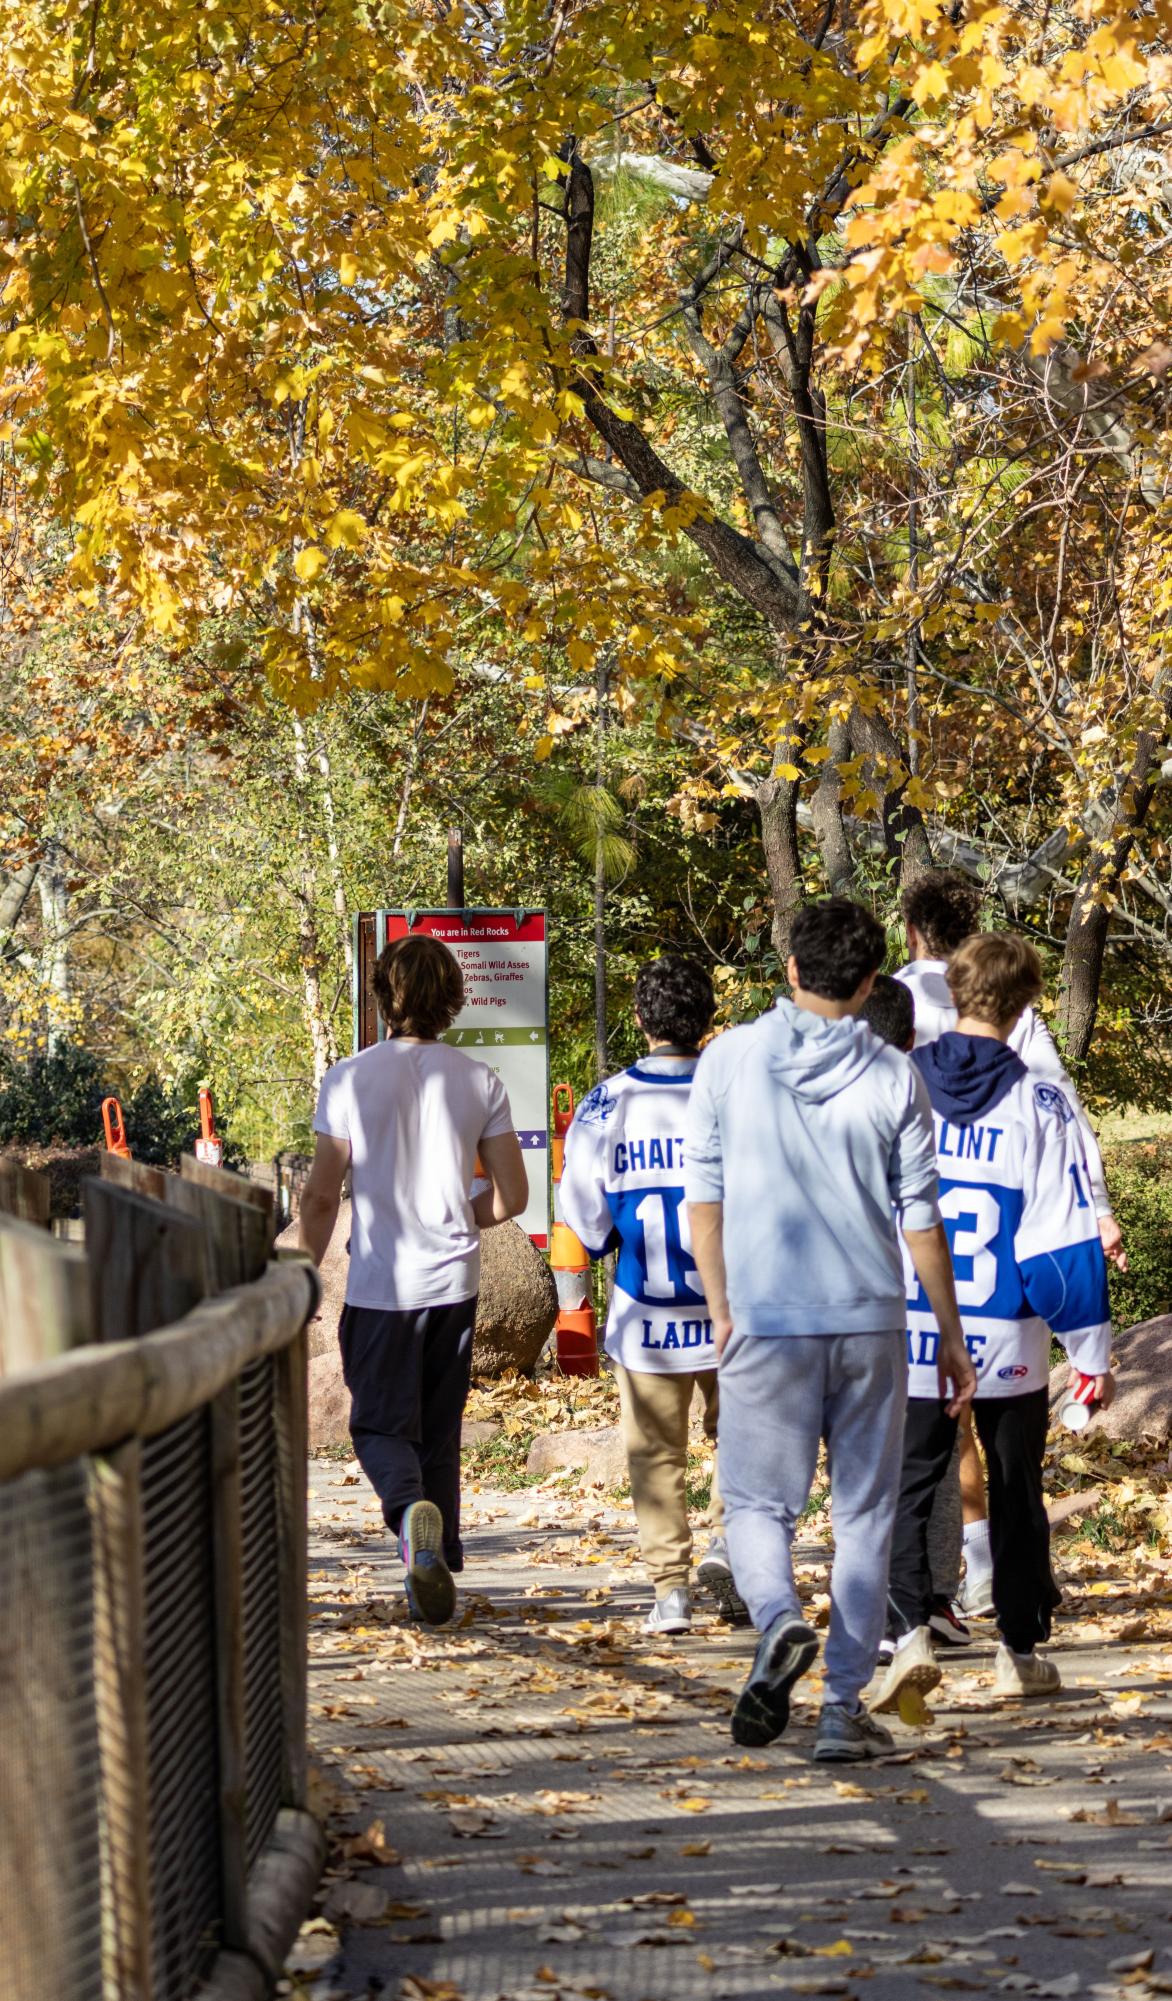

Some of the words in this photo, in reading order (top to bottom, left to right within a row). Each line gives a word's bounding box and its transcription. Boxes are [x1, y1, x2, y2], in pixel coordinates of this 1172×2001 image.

[431, 928, 445, 936] You
[461, 928, 468, 936] in
[470, 927, 485, 936] Red
[486, 927, 509, 936] Rocks
[457, 950, 480, 959] Tigers
[461, 961, 487, 970] Somali
[489, 961, 505, 969] Wild
[507, 961, 530, 969] Asses
[464, 973, 492, 982] Zebras,
[494, 973, 524, 981] Giraffes
[471, 998, 488, 1006] Wild
[490, 997, 507, 1006] Pigs
